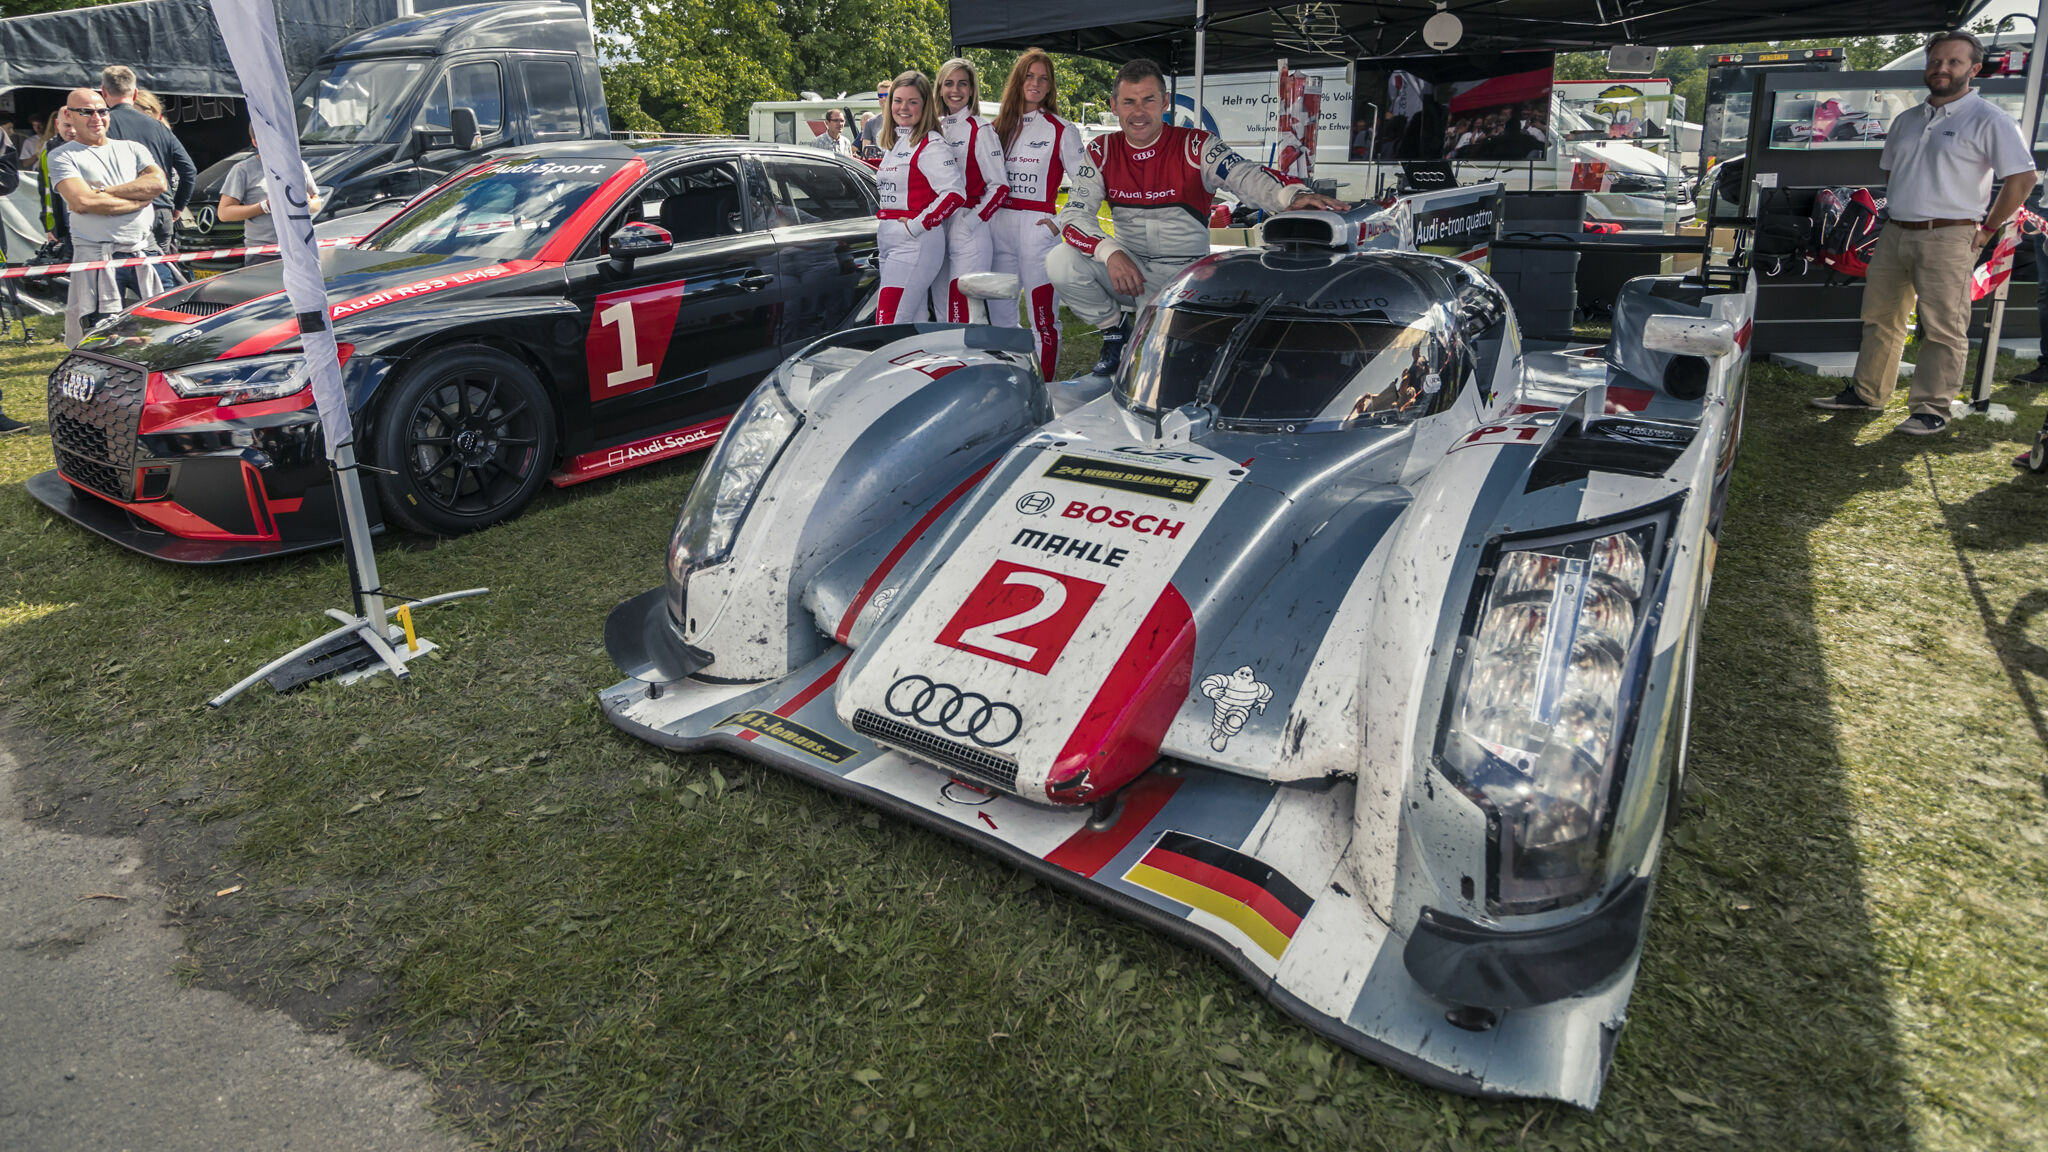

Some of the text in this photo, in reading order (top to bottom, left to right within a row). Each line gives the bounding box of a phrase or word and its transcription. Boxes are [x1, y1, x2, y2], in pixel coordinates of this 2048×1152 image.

[1222, 95, 1243, 105] Helt
[1245, 96, 1258, 107] ny
[494, 162, 607, 176] Audi Sport
[1019, 156, 1041, 164] Sport
[1118, 188, 1176, 201] Audi Sport
[942, 201, 956, 216] Sport
[1415, 217, 1439, 244] Audi
[1439, 214, 1465, 238] e-tron
[1465, 209, 1493, 232] quattro
[333, 268, 501, 317] Audi RS3 LMS
[600, 301, 654, 389] 1
[1465, 425, 1541, 444] P1
[1632, 427, 1674, 435] ACTION
[628, 429, 707, 460] Audi Sport
[1053, 465, 1083, 477] 24
[1082, 468, 1125, 480] HEURES
[1124, 473, 1144, 482] DU
[1142, 475, 1178, 488] MANS
[1060, 500, 1186, 540] BOSCH
[1011, 528, 1130, 569] MAHLE
[957, 571, 1069, 664] 2
